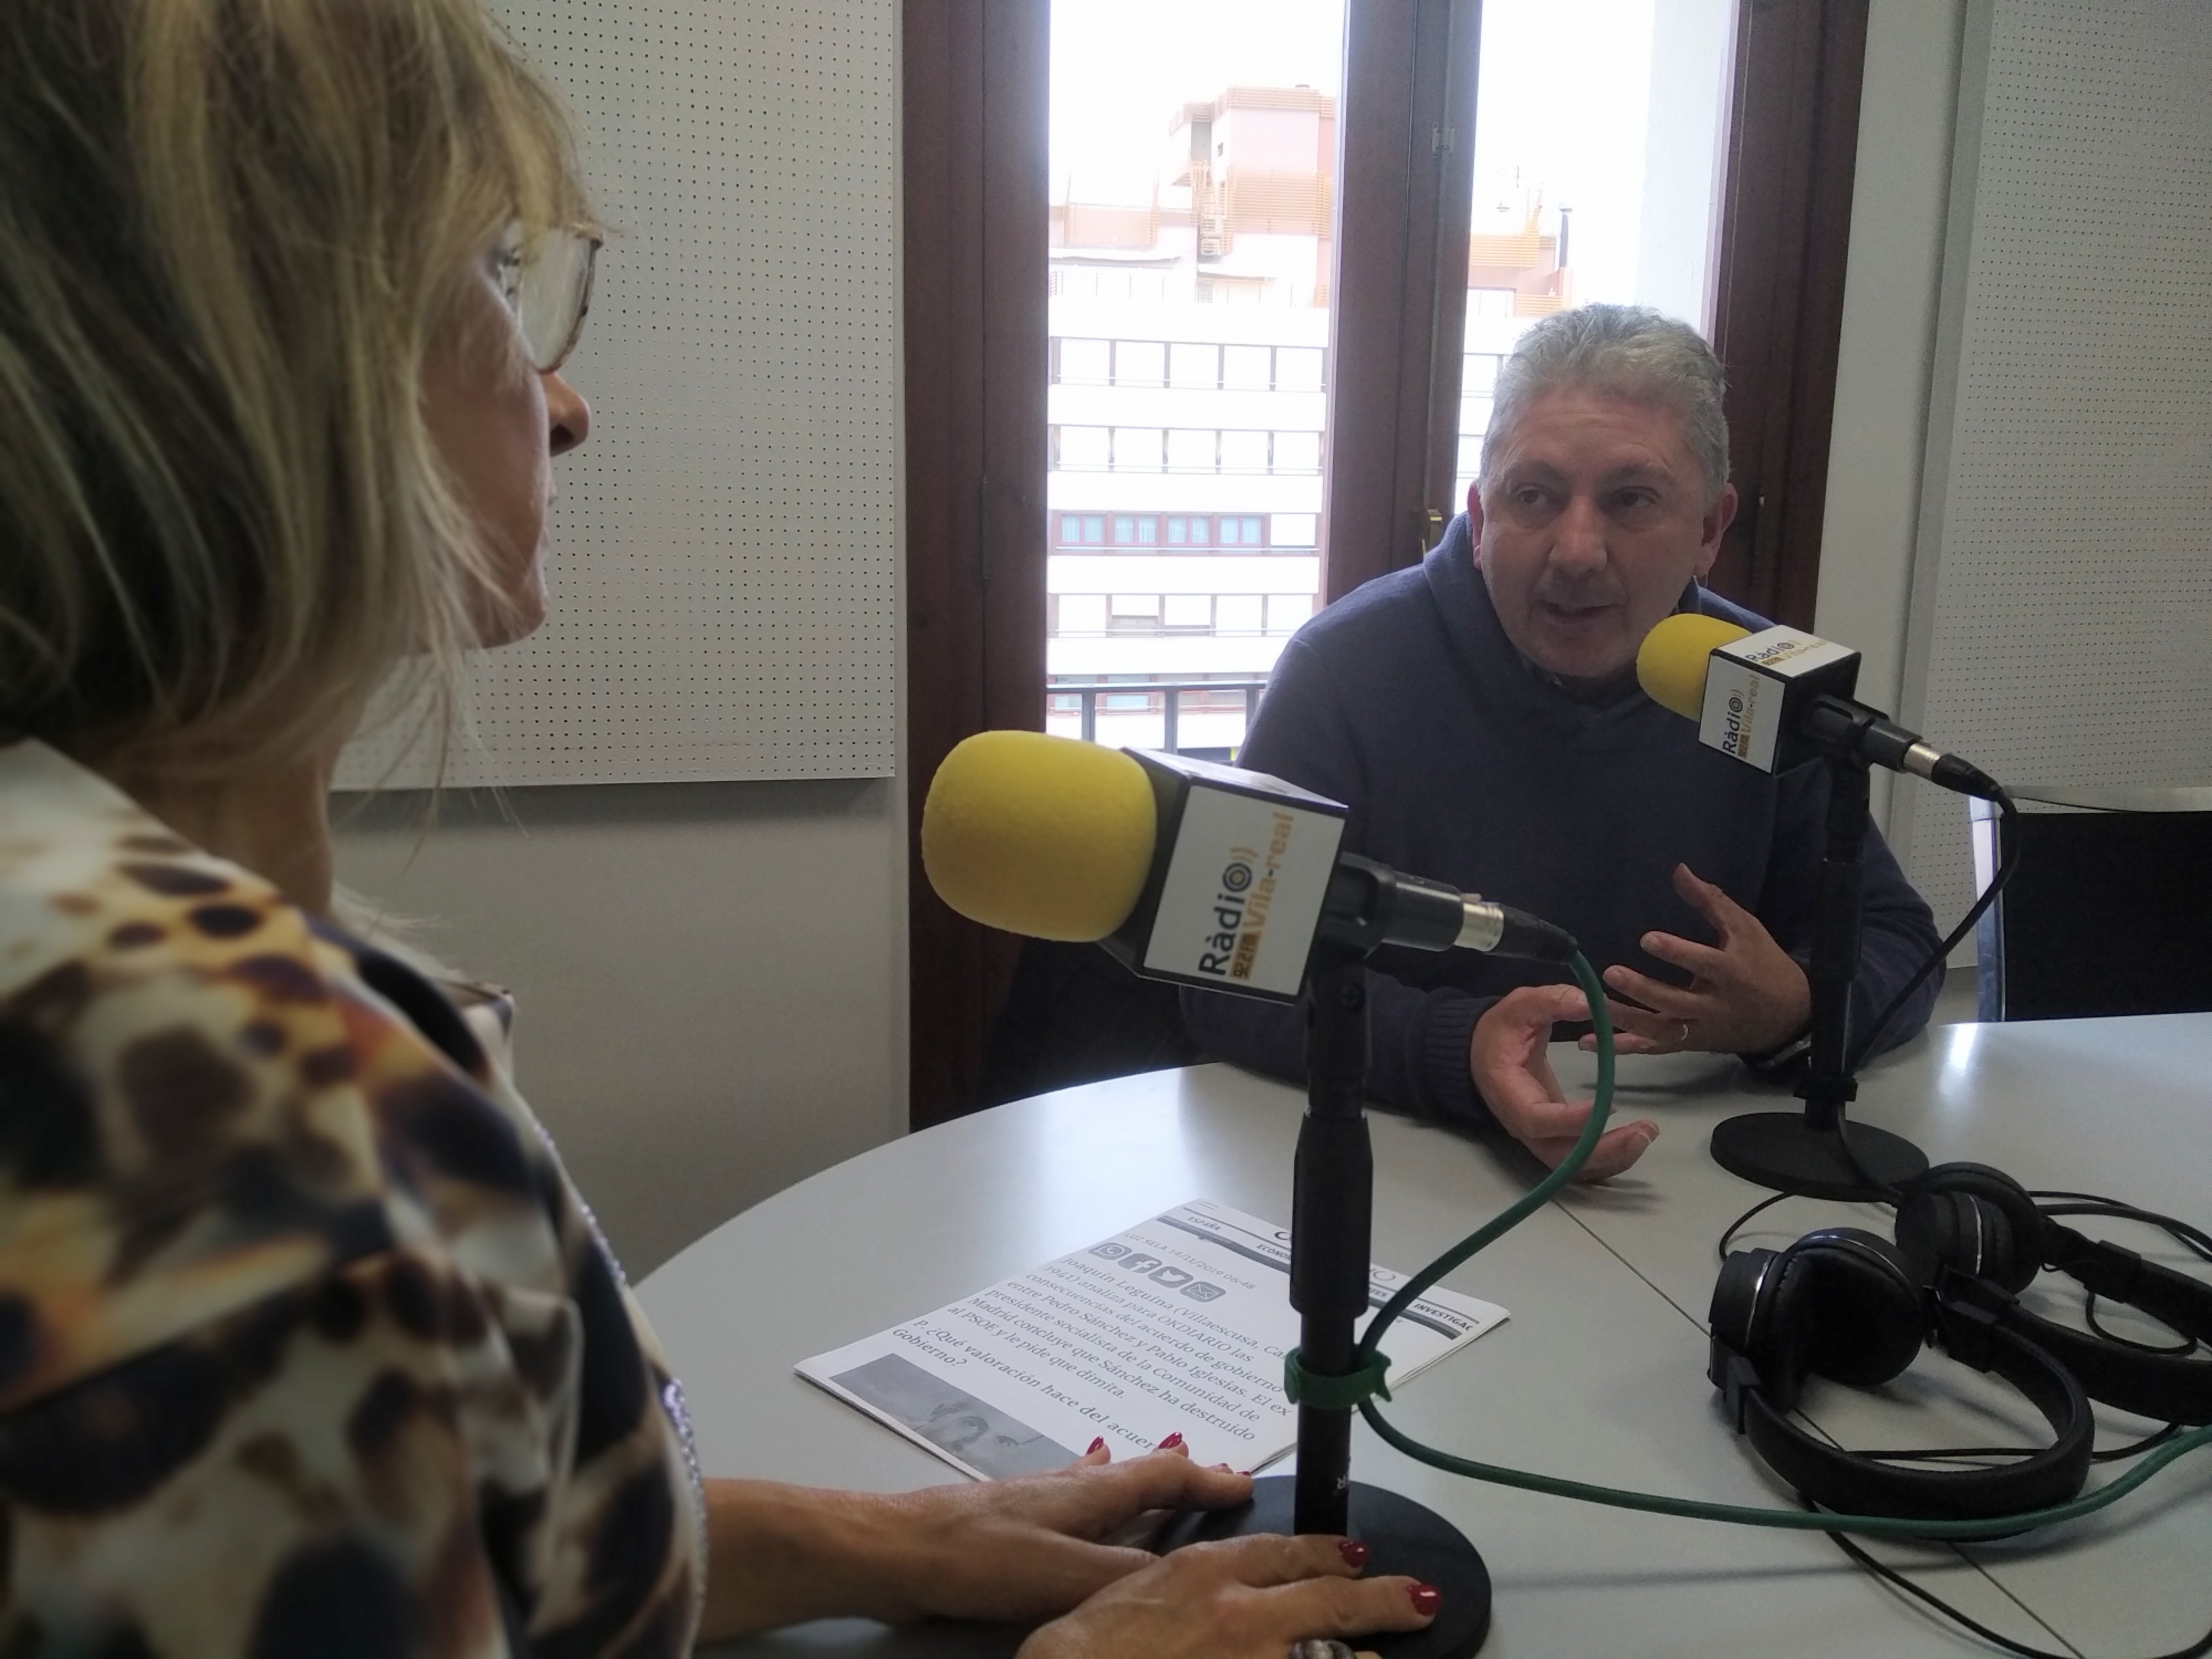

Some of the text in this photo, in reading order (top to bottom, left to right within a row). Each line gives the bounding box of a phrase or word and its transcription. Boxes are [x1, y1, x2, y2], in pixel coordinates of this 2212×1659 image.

[1723, 696, 1744, 753] Ràdio
[1740, 675, 1761, 733] Vila-real
[1198, 863, 1252, 975] Ràdio
[1244, 811, 1294, 931] Vila-real
[1187, 1215, 1221, 1230] ESPAÑA
[1256, 1244, 1291, 1260] ECONO
[893, 1328, 967, 1366] Gobierno?
[947, 1306, 967, 1314] al
[961, 1311, 999, 1331] PSOE
[1004, 1332, 1020, 1343] le
[1014, 1340, 1051, 1358] pide
[1048, 1357, 1077, 1371] que
[1076, 1370, 1124, 1399] dimita.
[1006, 1281, 1042, 1298] entre
[1040, 1295, 1080, 1314] Pedro
[1078, 1312, 1136, 1342] Sánchez
[1145, 1344, 1187, 1368] Pablo
[1187, 1365, 1247, 1397] Iglesias.
[1250, 1394, 1272, 1406] El
[1270, 1404, 1291, 1416] ex
[1025, 1274, 1286, 1392] consecuencias del acuerdo de gobierno
[1060, 1258, 1115, 1282] Joaquín
[1115, 1280, 1174, 1310] Leguina
[1173, 1307, 1258, 1349] (Villaescusa,
[1077, 1280, 1125, 1303] analiza
[1121, 1302, 1157, 1318] para
[1157, 1316, 1232, 1351] OKDIARIO
[1229, 1347, 1254, 1362] las
[925, 1328, 968, 1347] ¿Qué
[964, 1345, 1041, 1387] valoración
[1040, 1384, 1079, 1407] hace
[1079, 1406, 1110, 1423] del
[1106, 1422, 1156, 1449] acuer
[967, 1297, 1255, 1440] Madrid concluye que Sánchez ha destruido
[984, 1290, 1260, 1421] presidente socialista de la Comunidad de
